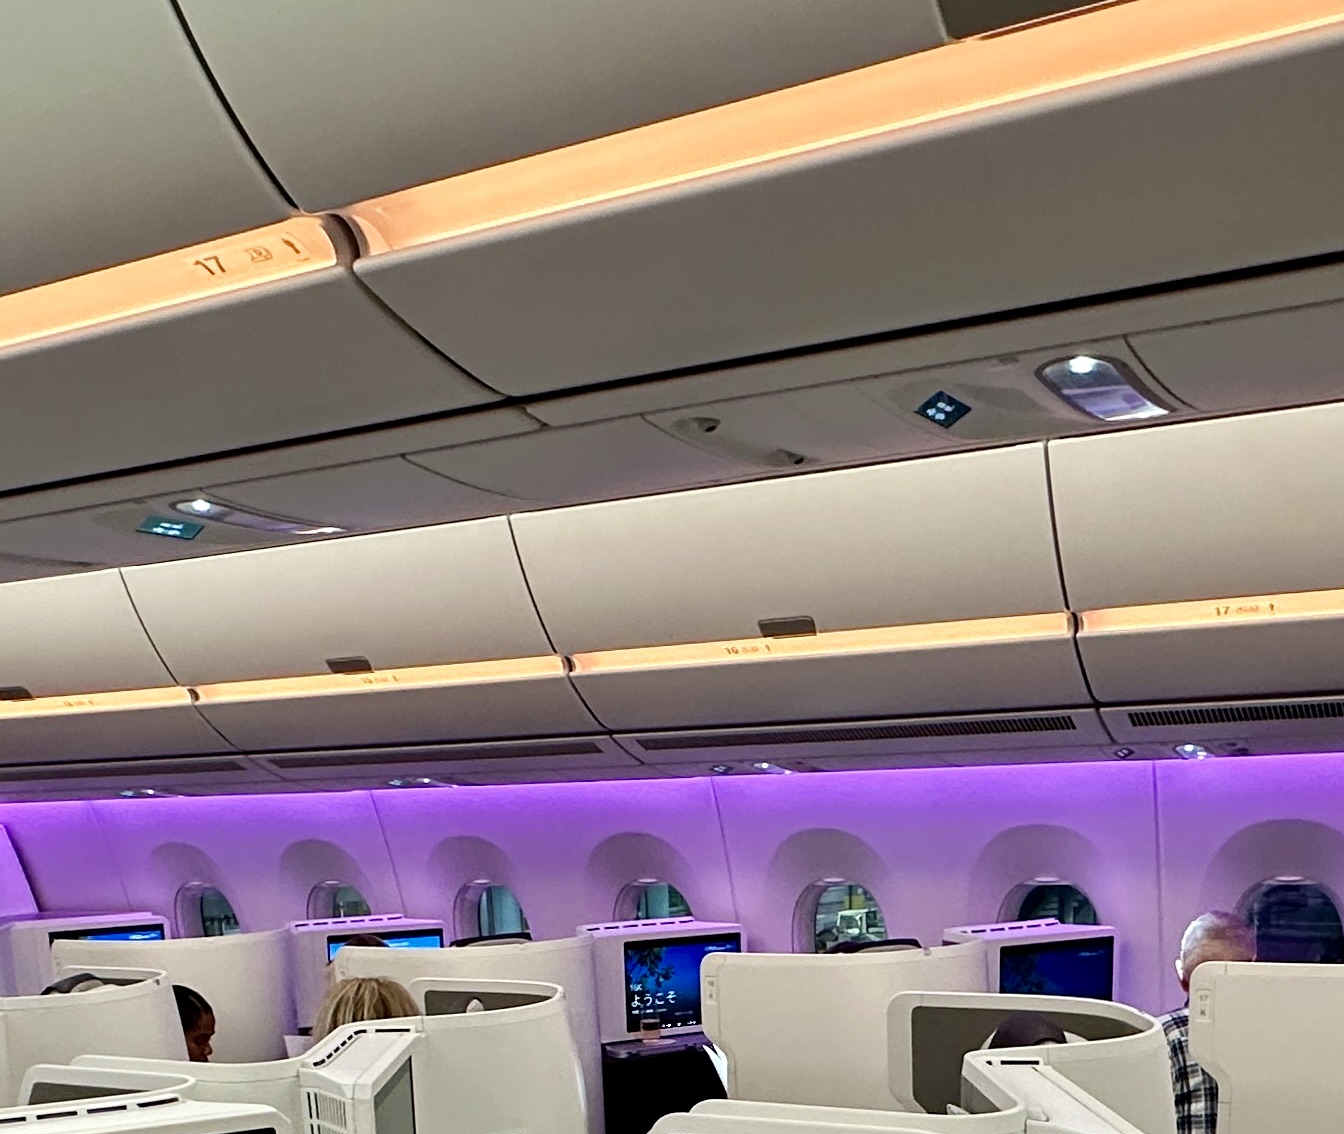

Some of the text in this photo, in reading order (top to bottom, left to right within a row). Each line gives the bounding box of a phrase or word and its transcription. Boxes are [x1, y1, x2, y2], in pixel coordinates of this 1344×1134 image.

[192, 255, 227, 276] 17
[1214, 605, 1231, 616] 17
[631, 990, 677, 1007] ようこそ
